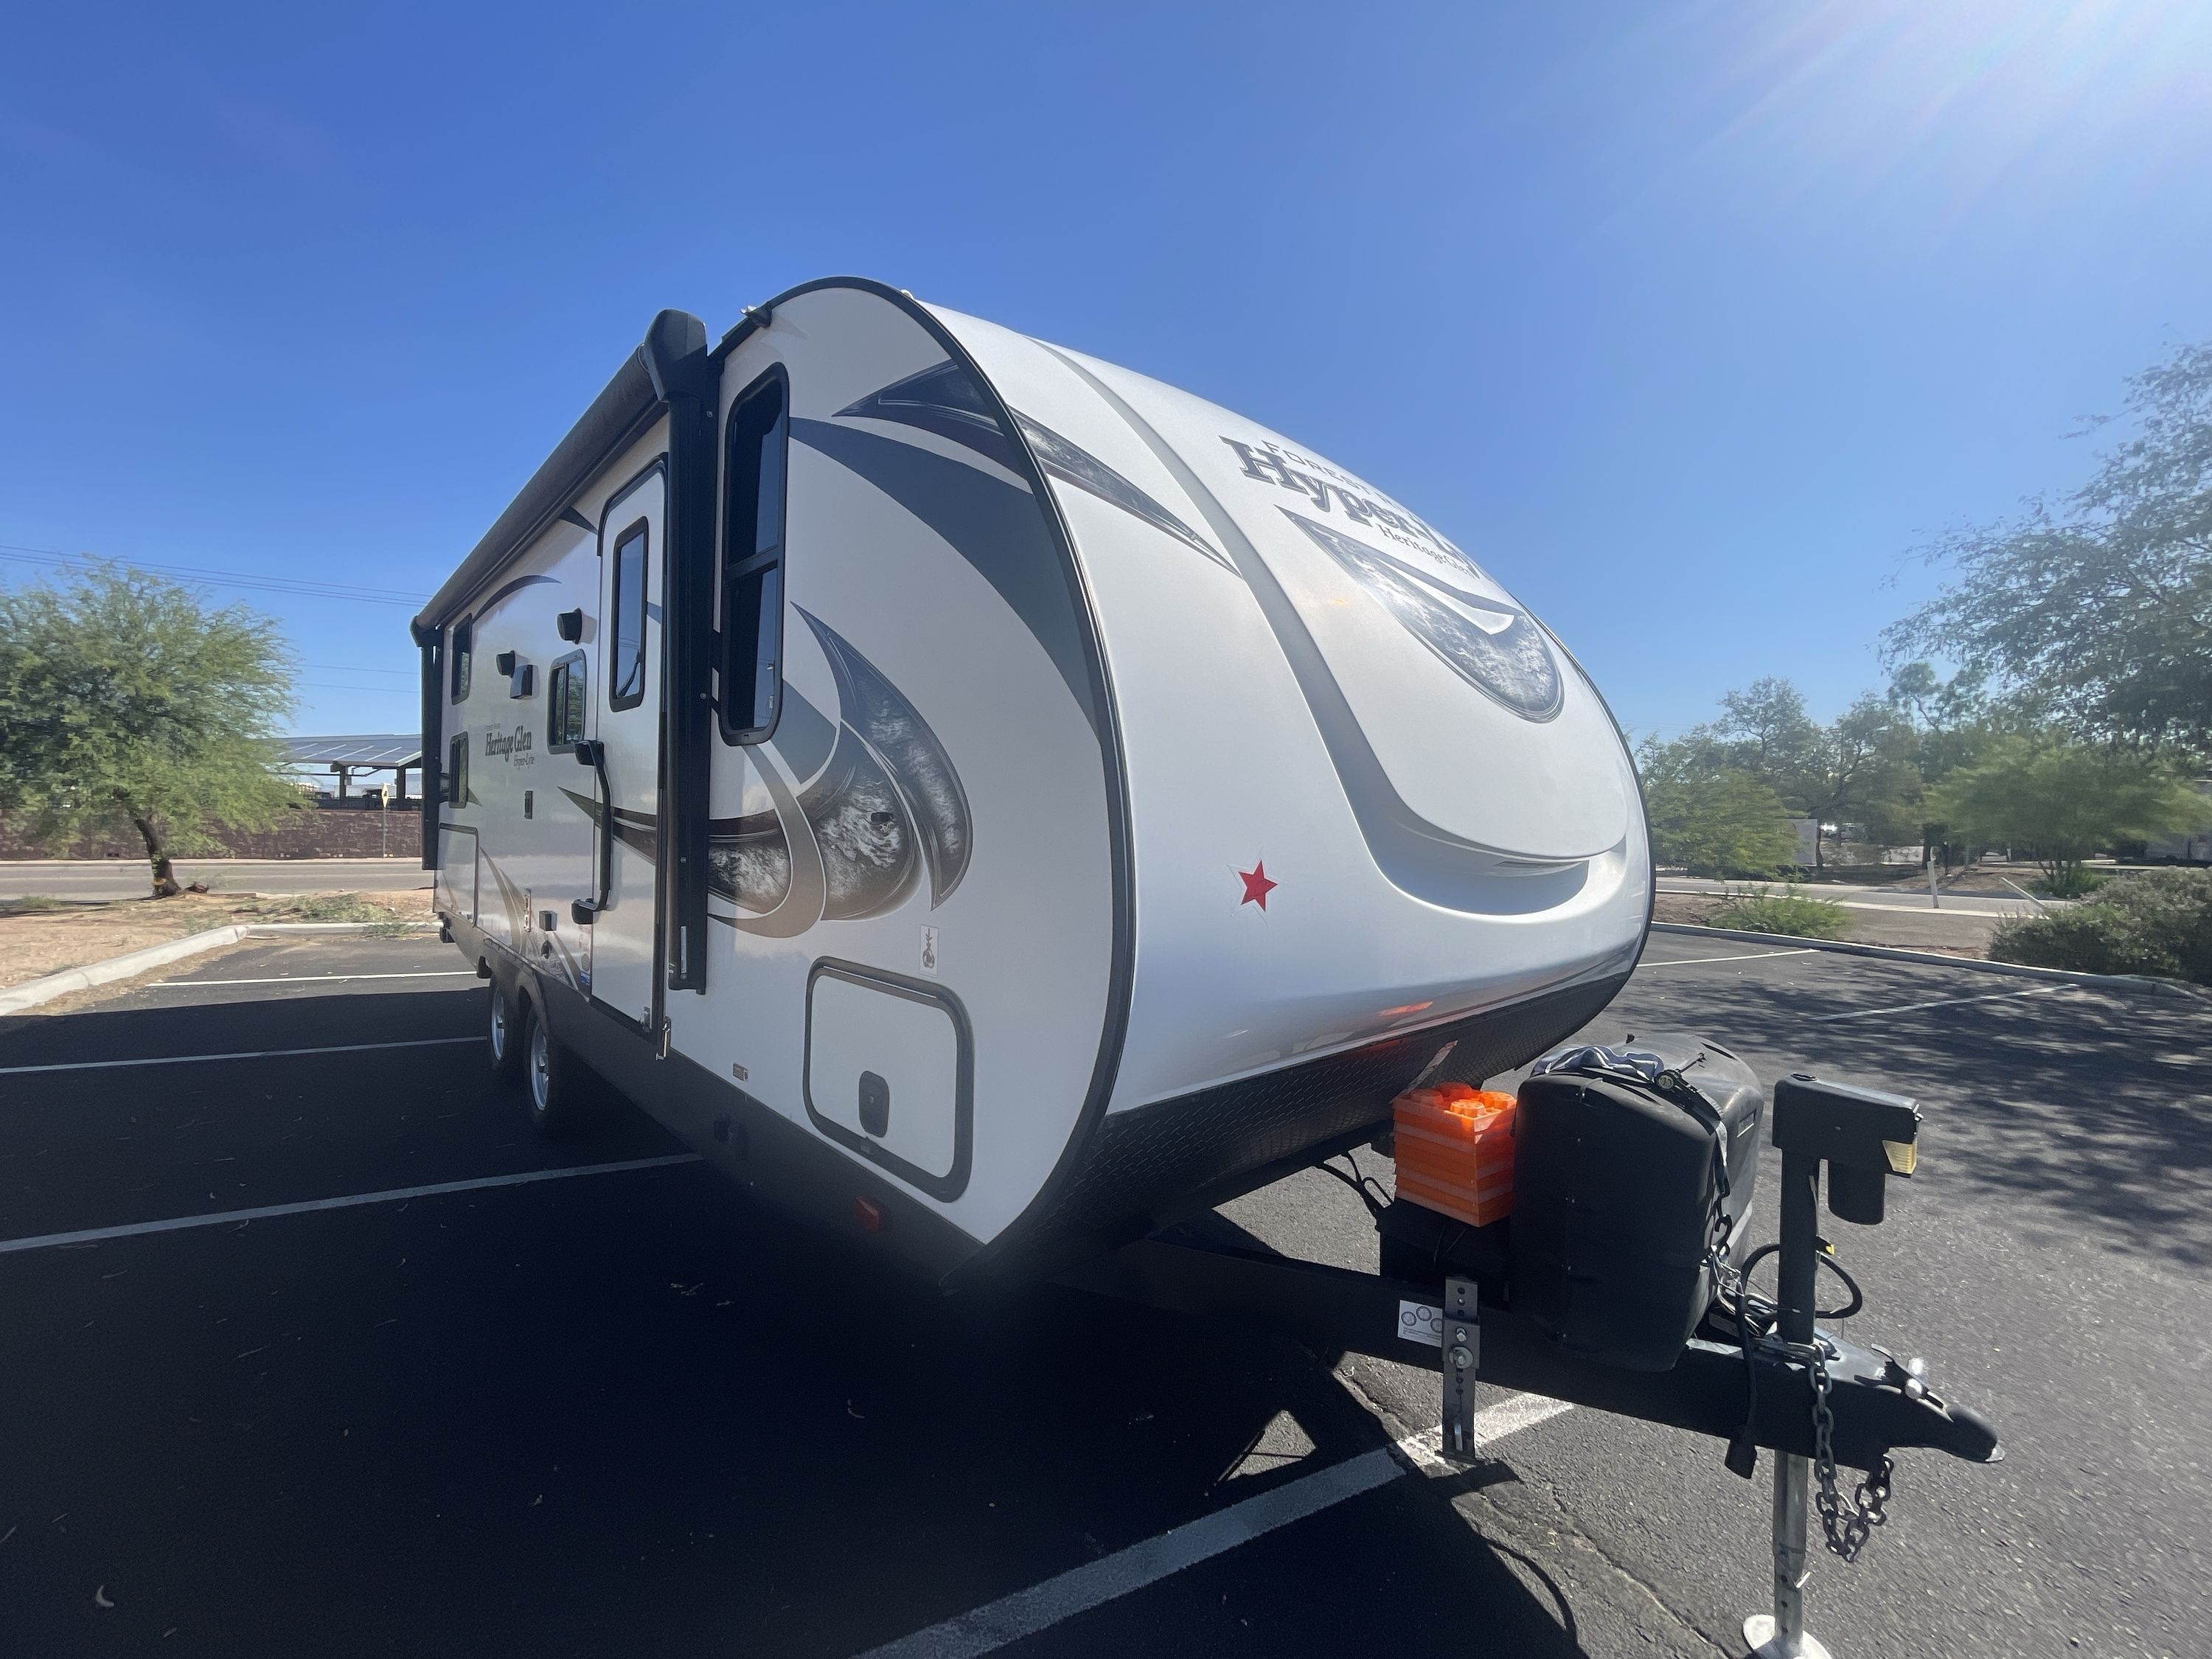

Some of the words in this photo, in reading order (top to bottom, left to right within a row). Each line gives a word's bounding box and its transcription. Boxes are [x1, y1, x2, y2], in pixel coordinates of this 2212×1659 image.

[1261, 439, 1371, 495] FOREST
[485, 731, 514, 762] Heritage
[515, 725, 532, 751] Glen
